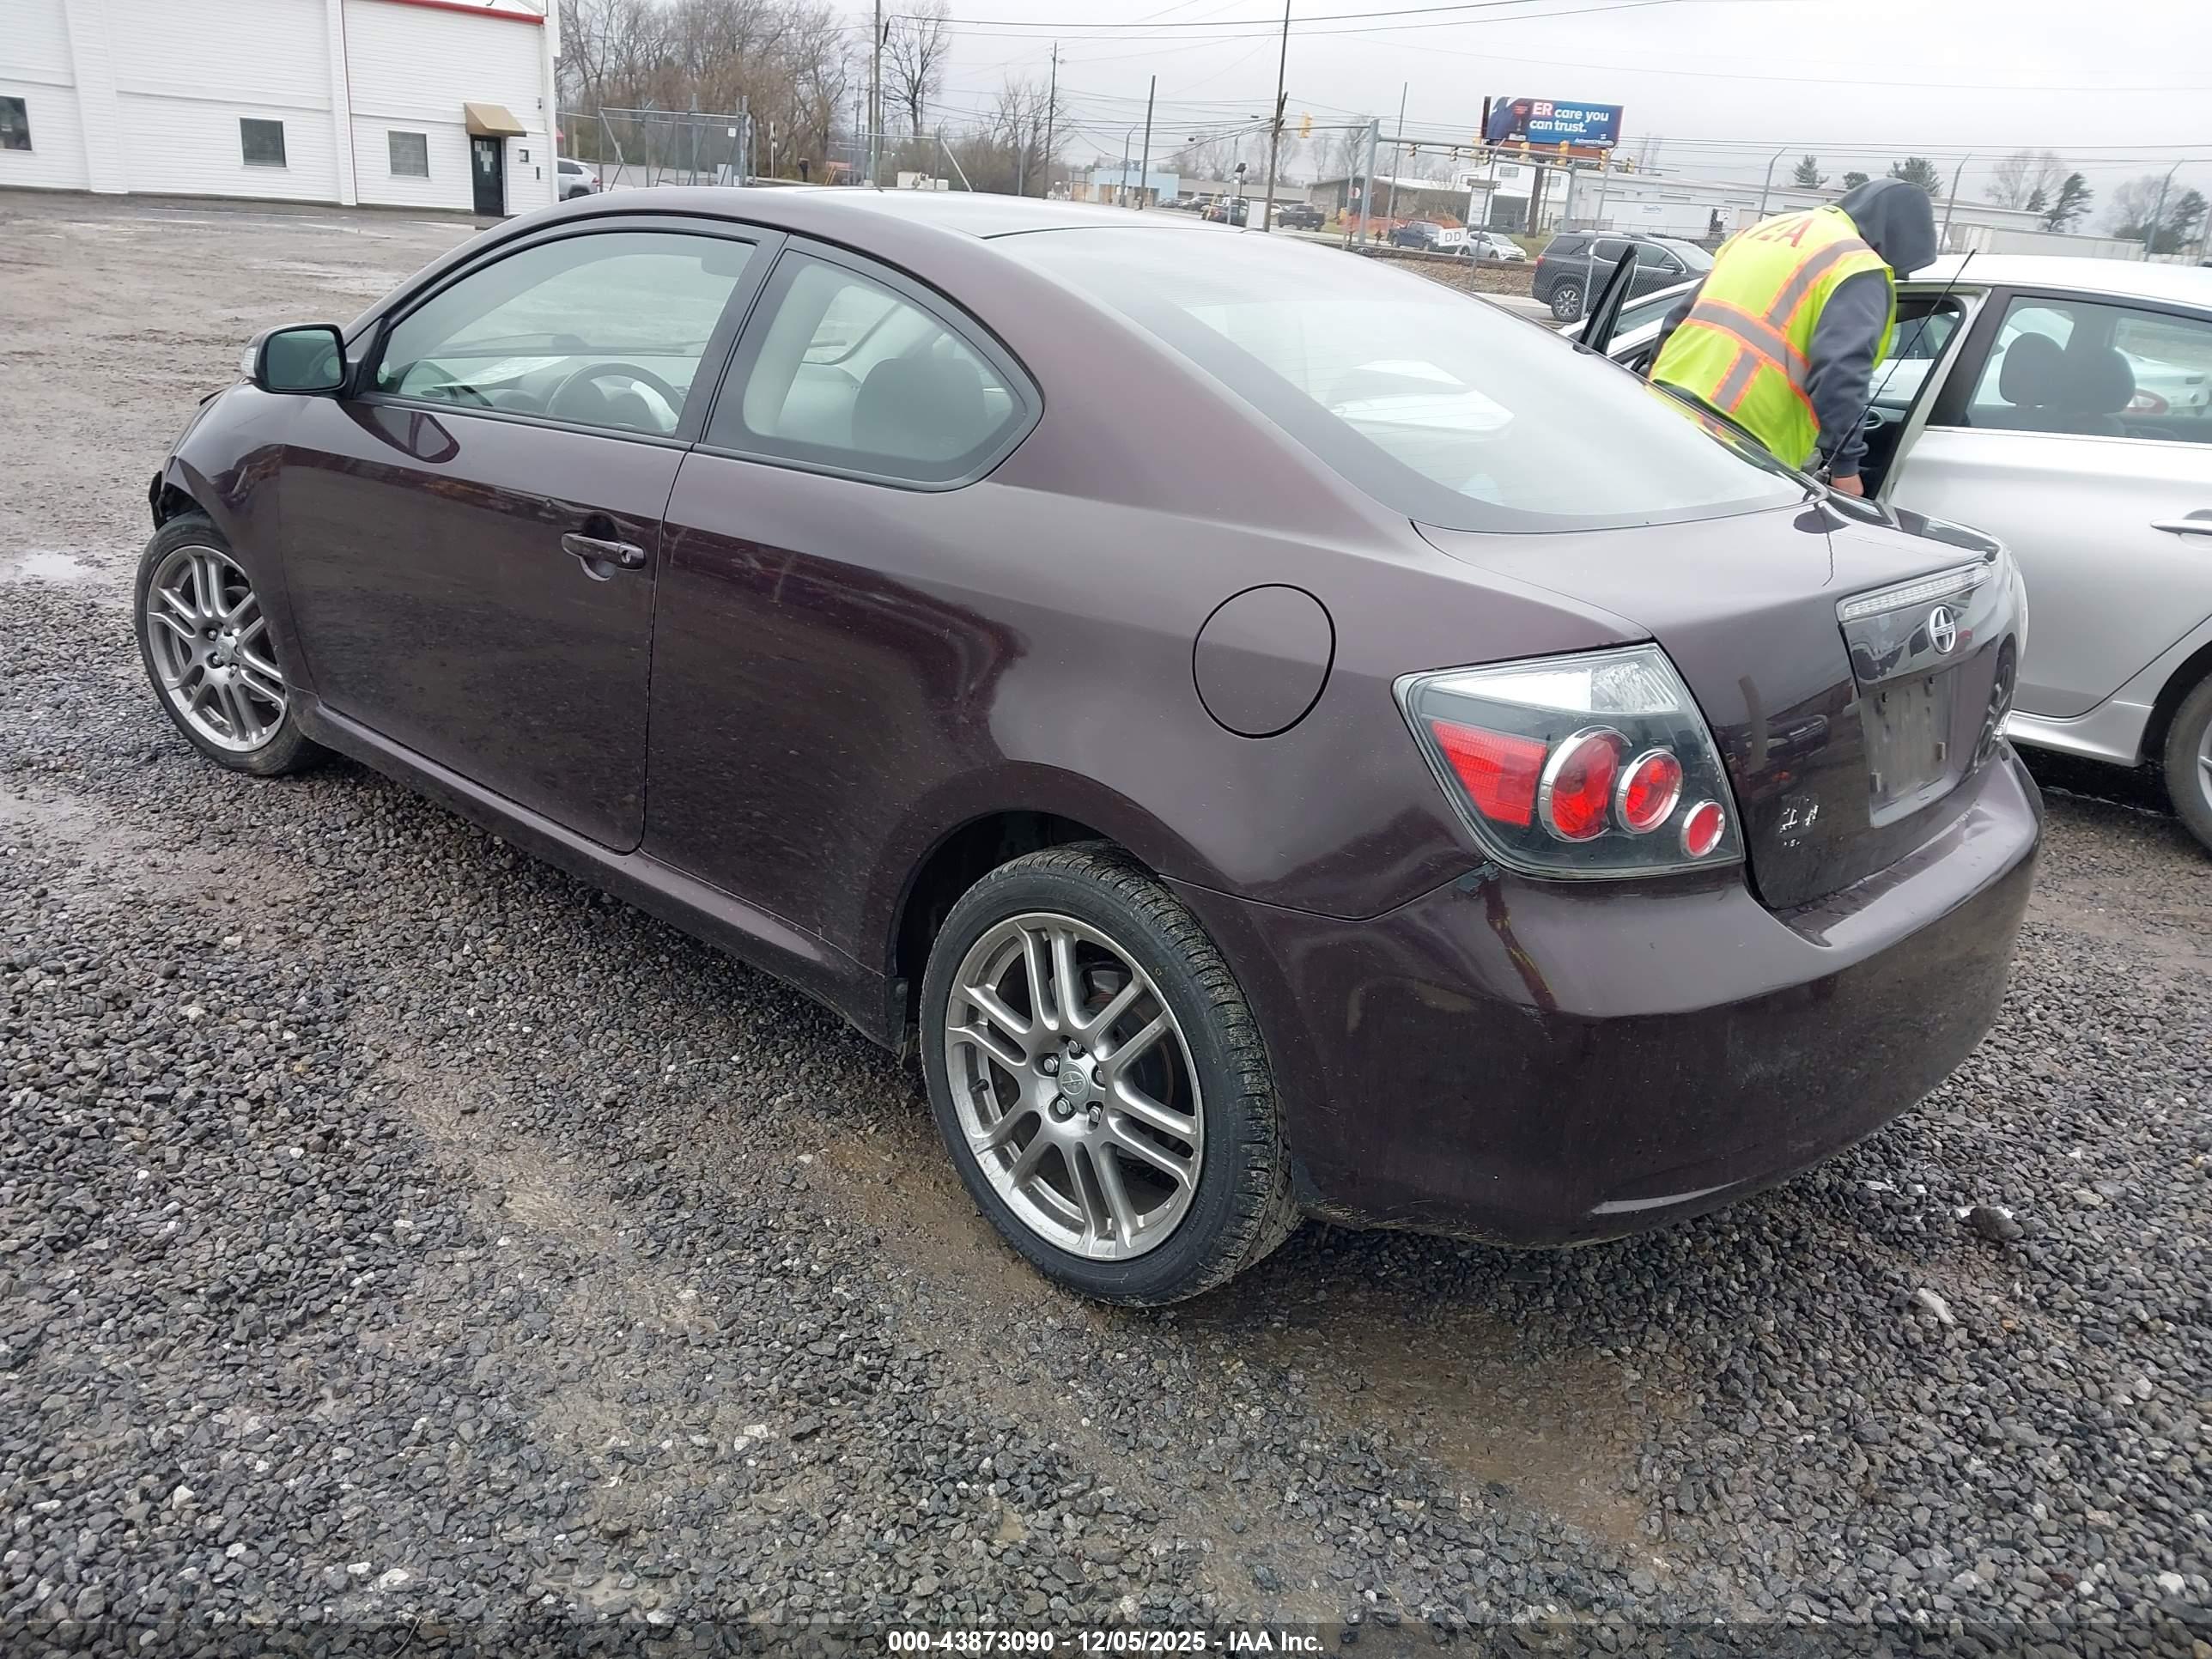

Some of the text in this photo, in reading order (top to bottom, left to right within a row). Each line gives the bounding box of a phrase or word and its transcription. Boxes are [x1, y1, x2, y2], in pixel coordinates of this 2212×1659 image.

[1532, 102, 1553, 116] ER
[1554, 107, 1582, 119] care
[1586, 111, 1609, 123] you
[1529, 119, 1587, 132] can trust.
[1445, 232, 1462, 241] DD
